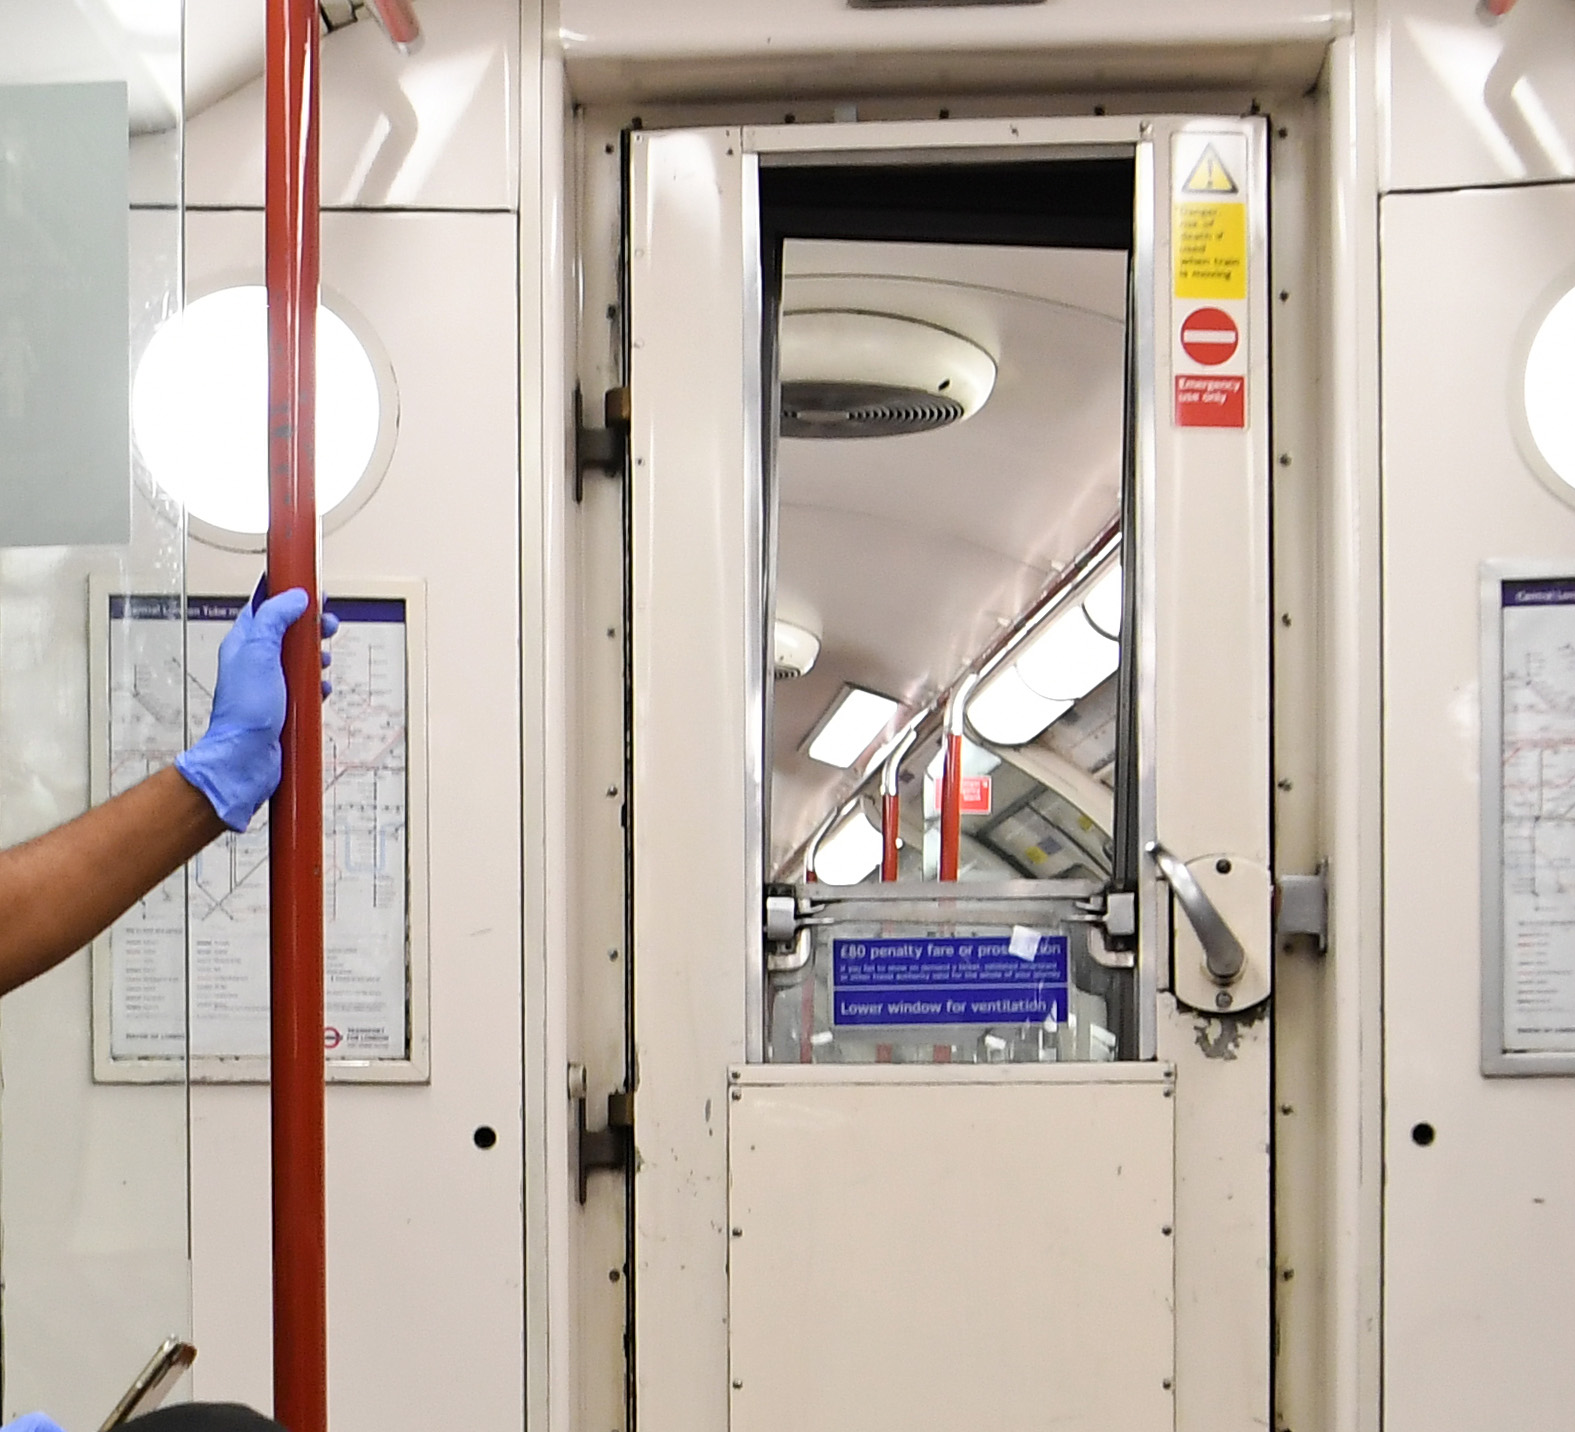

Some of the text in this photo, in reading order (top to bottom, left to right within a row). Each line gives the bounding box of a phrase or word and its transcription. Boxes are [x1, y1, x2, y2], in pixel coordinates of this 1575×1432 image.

[1178, 377, 1241, 393] Emergency
[1178, 390, 1228, 406] use only
[840, 944, 866, 959] £80
[870, 944, 923, 961] penalty
[927, 943, 955, 958] fare
[958, 945, 974, 958] or
[840, 999, 1047, 1016] Lower window for ventilation
